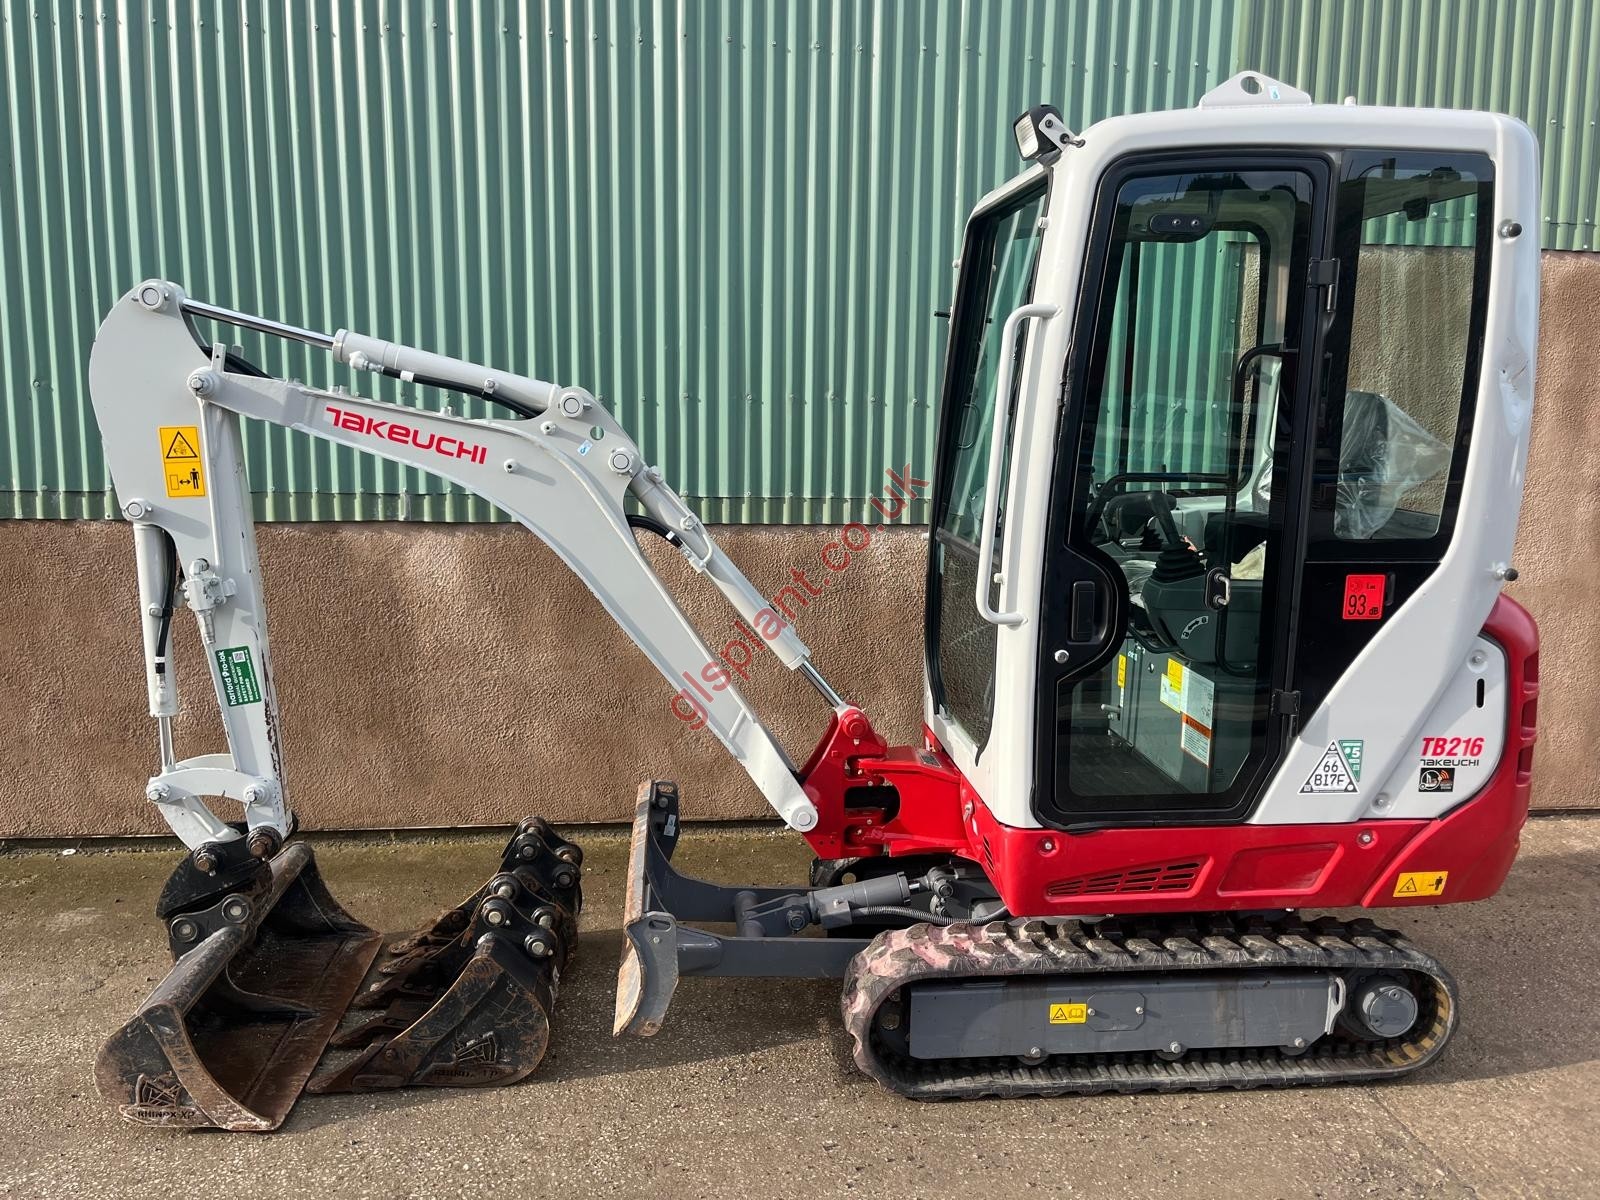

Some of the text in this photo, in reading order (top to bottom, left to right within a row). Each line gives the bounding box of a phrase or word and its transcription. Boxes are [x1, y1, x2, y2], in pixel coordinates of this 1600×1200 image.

[1348, 595, 1366, 615] 93
[1422, 738, 1485, 756] TB216
[1324, 760, 1338, 772] 66
